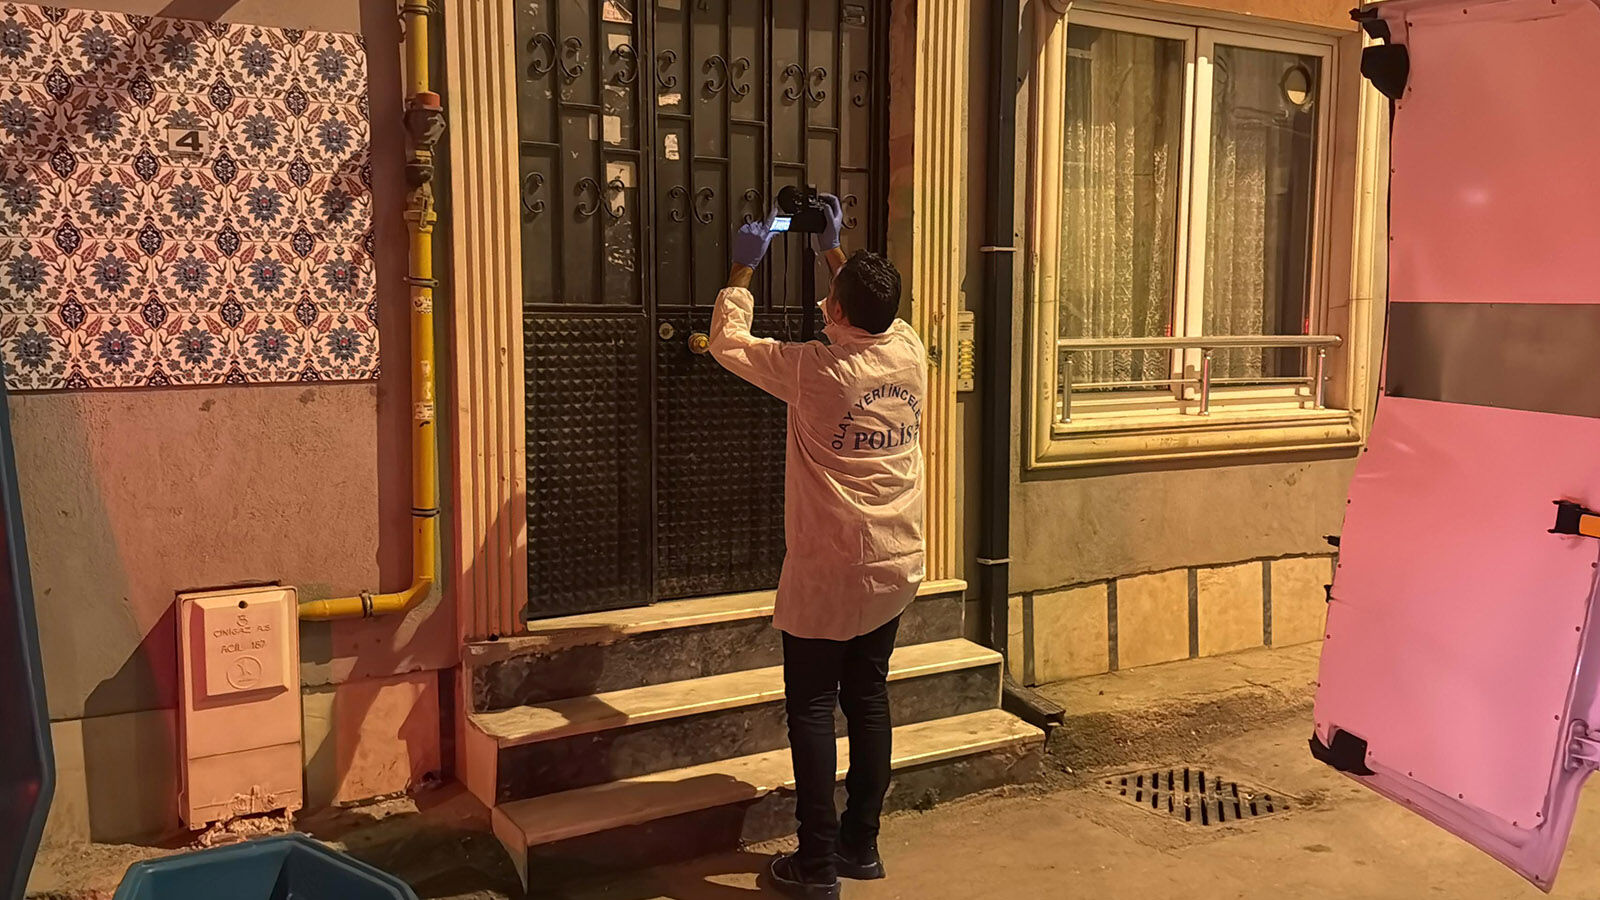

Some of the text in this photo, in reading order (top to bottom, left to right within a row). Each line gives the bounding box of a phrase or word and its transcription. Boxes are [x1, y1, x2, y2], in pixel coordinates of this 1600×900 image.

[176, 131, 203, 151] 4
[831, 411, 855, 450] OLAY
[853, 422, 914, 450] POLİS
[251, 639, 266, 650] 187
